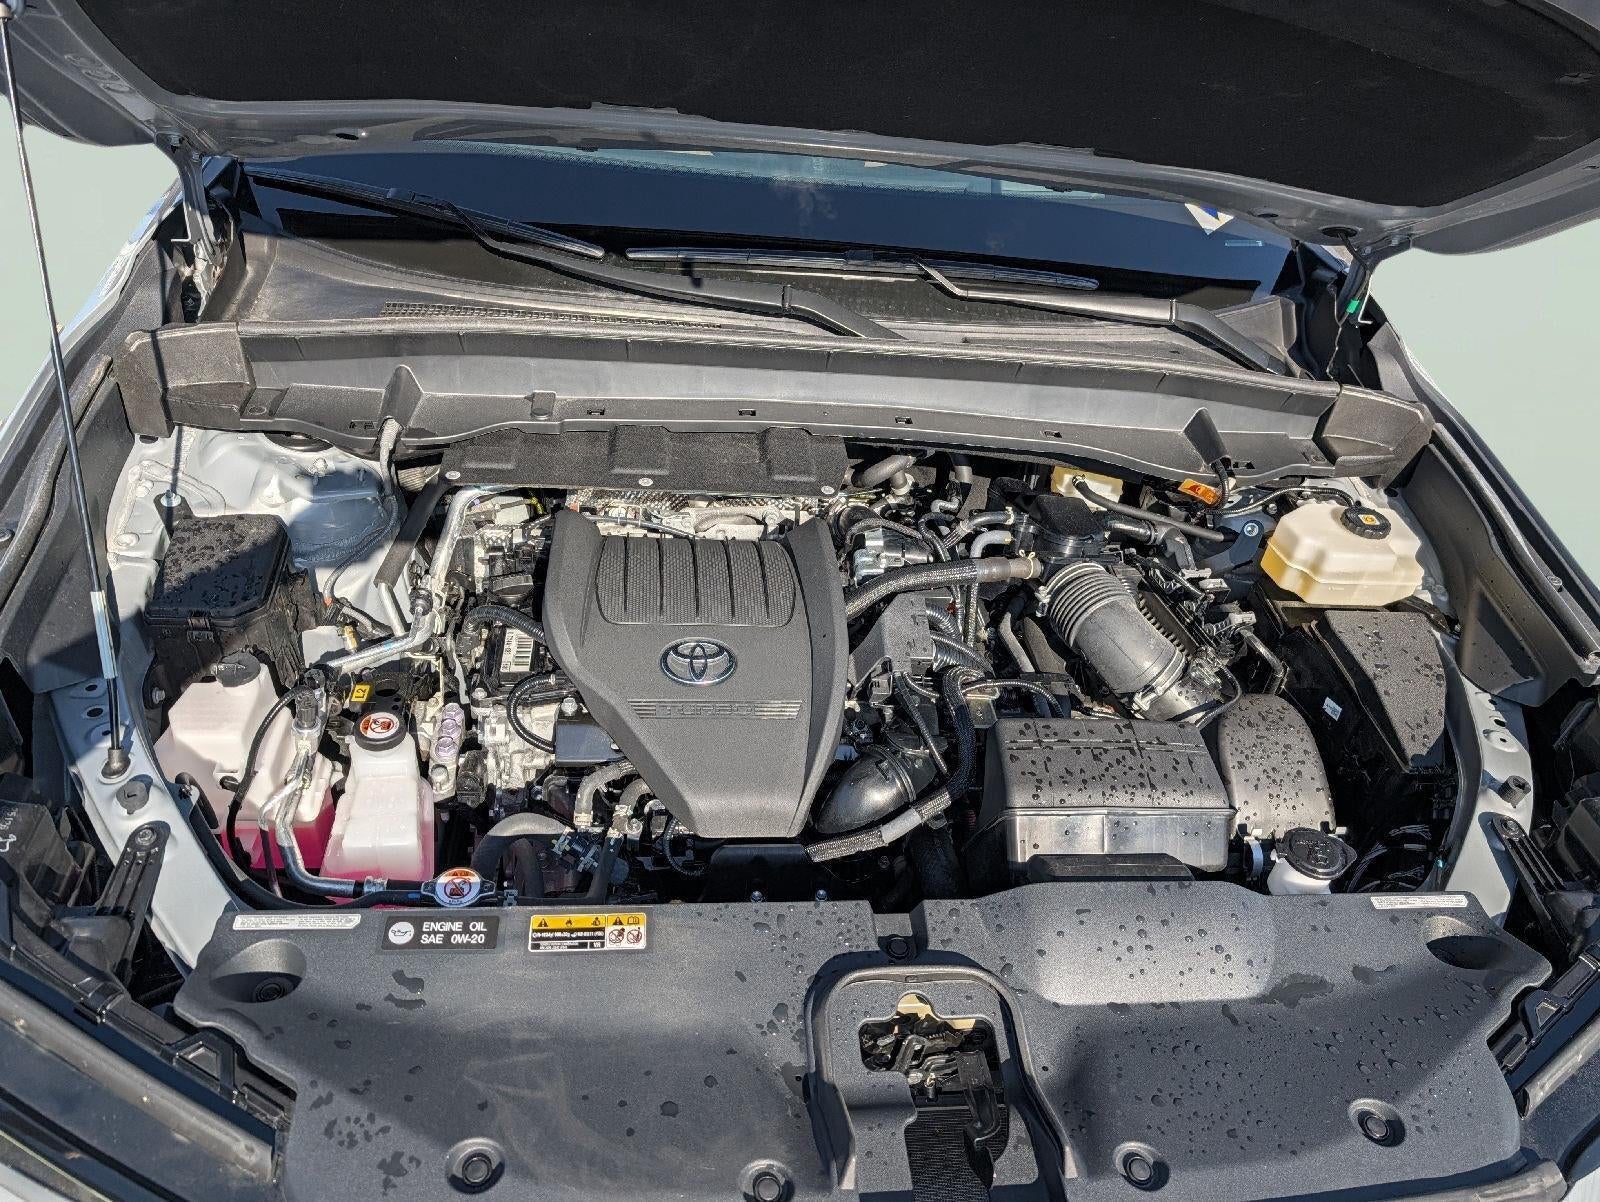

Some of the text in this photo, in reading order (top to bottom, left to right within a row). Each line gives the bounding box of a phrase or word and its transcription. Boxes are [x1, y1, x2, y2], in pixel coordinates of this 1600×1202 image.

[355, 688, 367, 699] L2
[422, 921, 488, 932] ENGINE OIL
[420, 933, 486, 944] SAE 0W-20
